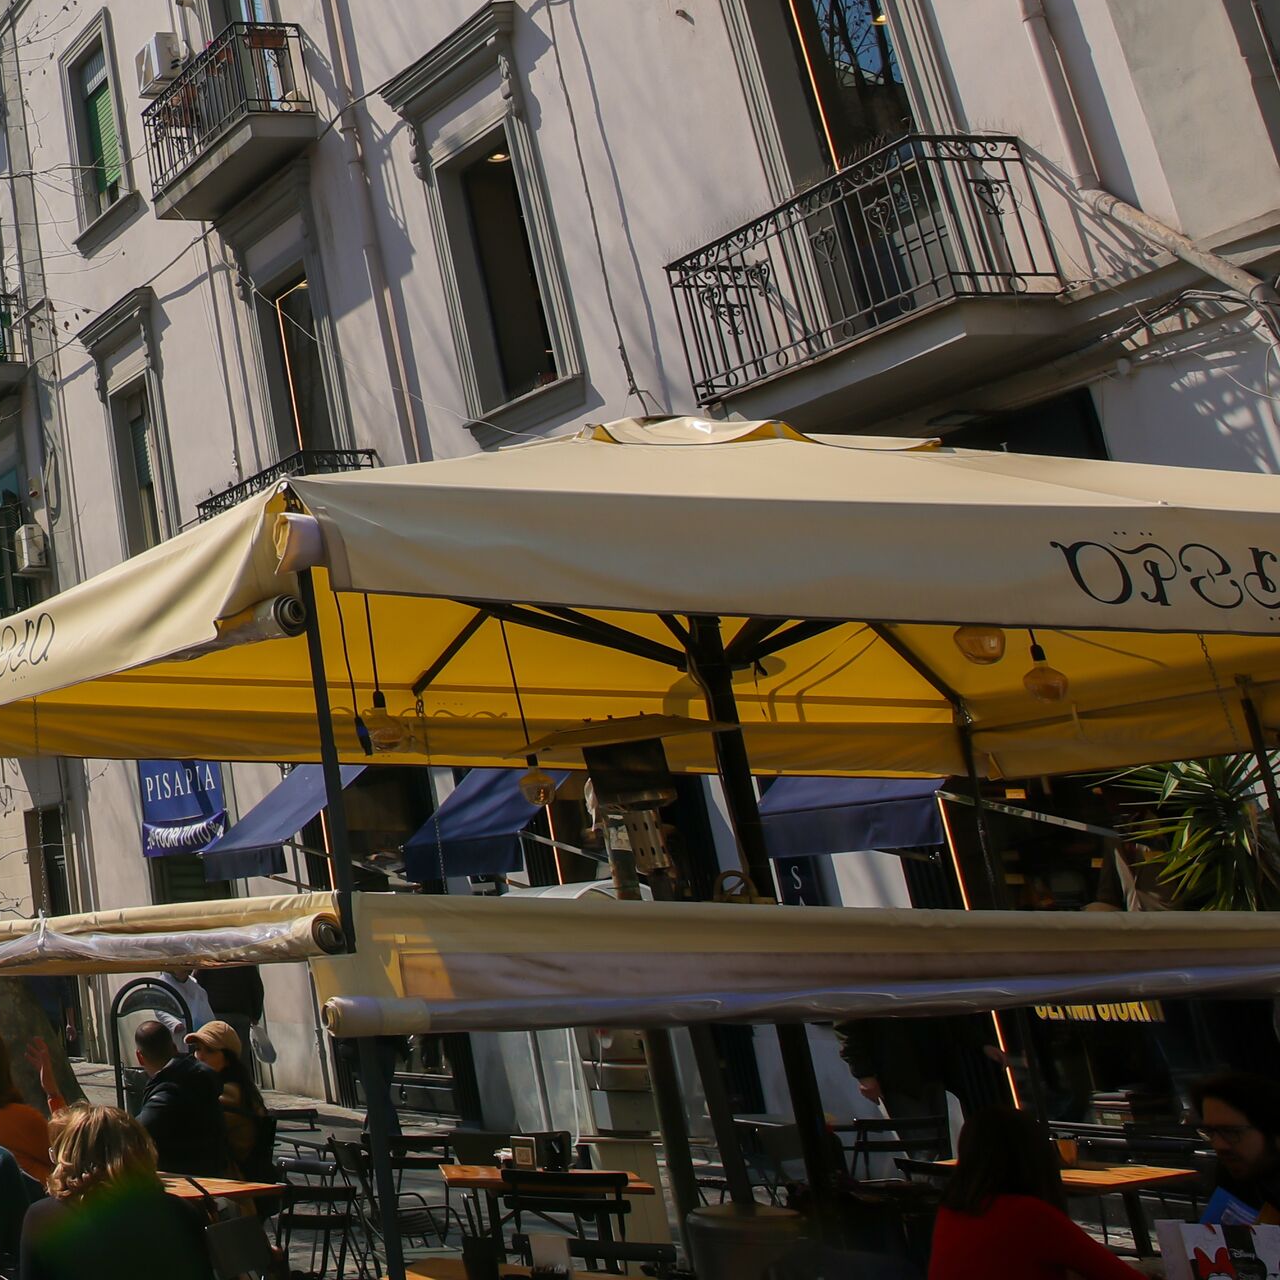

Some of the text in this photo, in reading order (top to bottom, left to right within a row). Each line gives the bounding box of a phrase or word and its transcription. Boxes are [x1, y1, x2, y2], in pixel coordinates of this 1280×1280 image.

[145, 763, 216, 802] PISAPIA
[154, 826, 183, 849] FUORI
[180, 821, 212, 847] TUTTO
